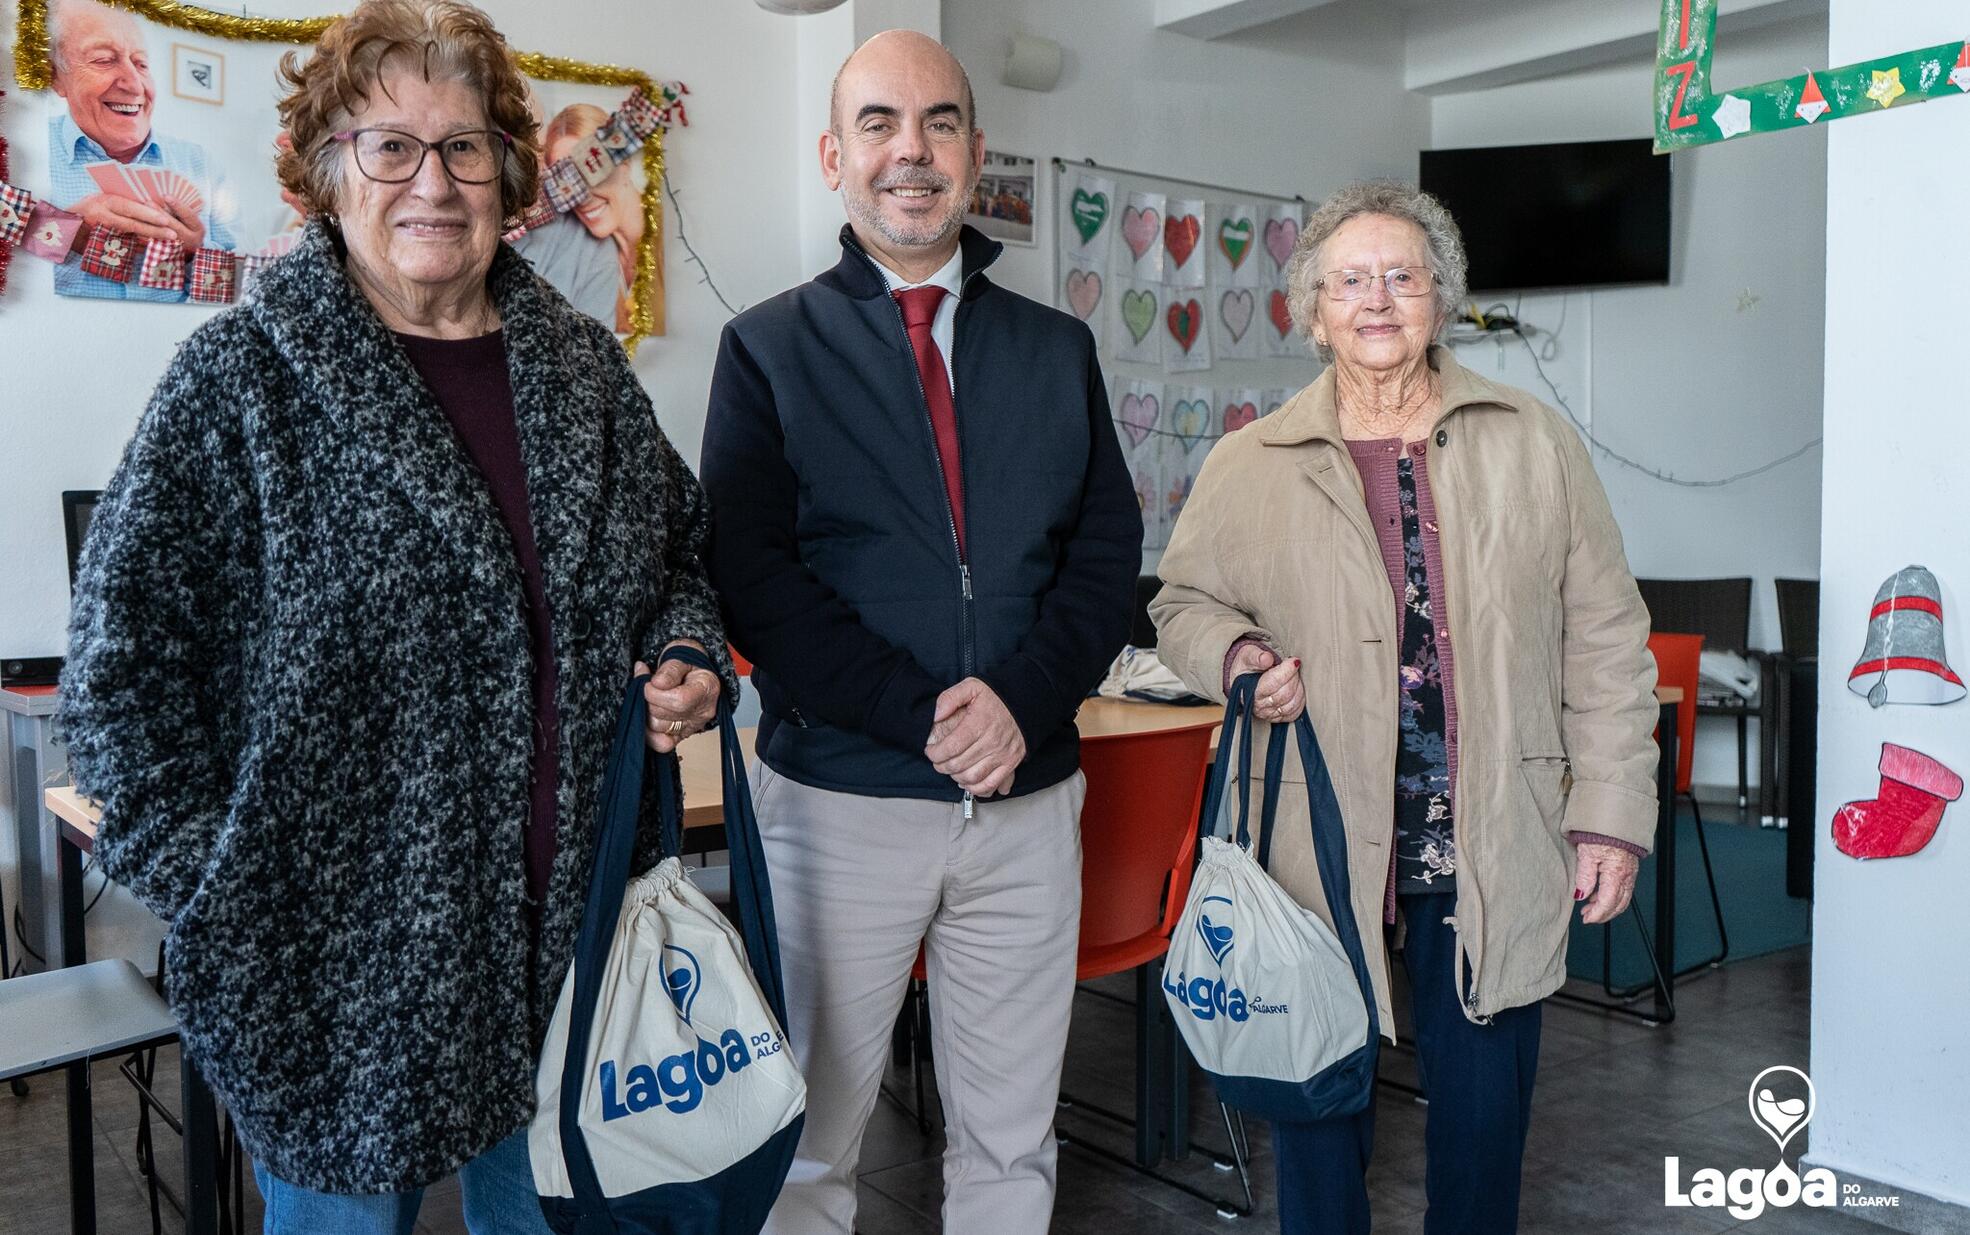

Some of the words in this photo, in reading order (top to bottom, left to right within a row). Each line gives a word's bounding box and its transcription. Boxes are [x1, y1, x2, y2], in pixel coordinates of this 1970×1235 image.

[46, 231, 53, 240] 9
[750, 1032, 771, 1046] DO
[599, 1028, 752, 1122] Lagoa
